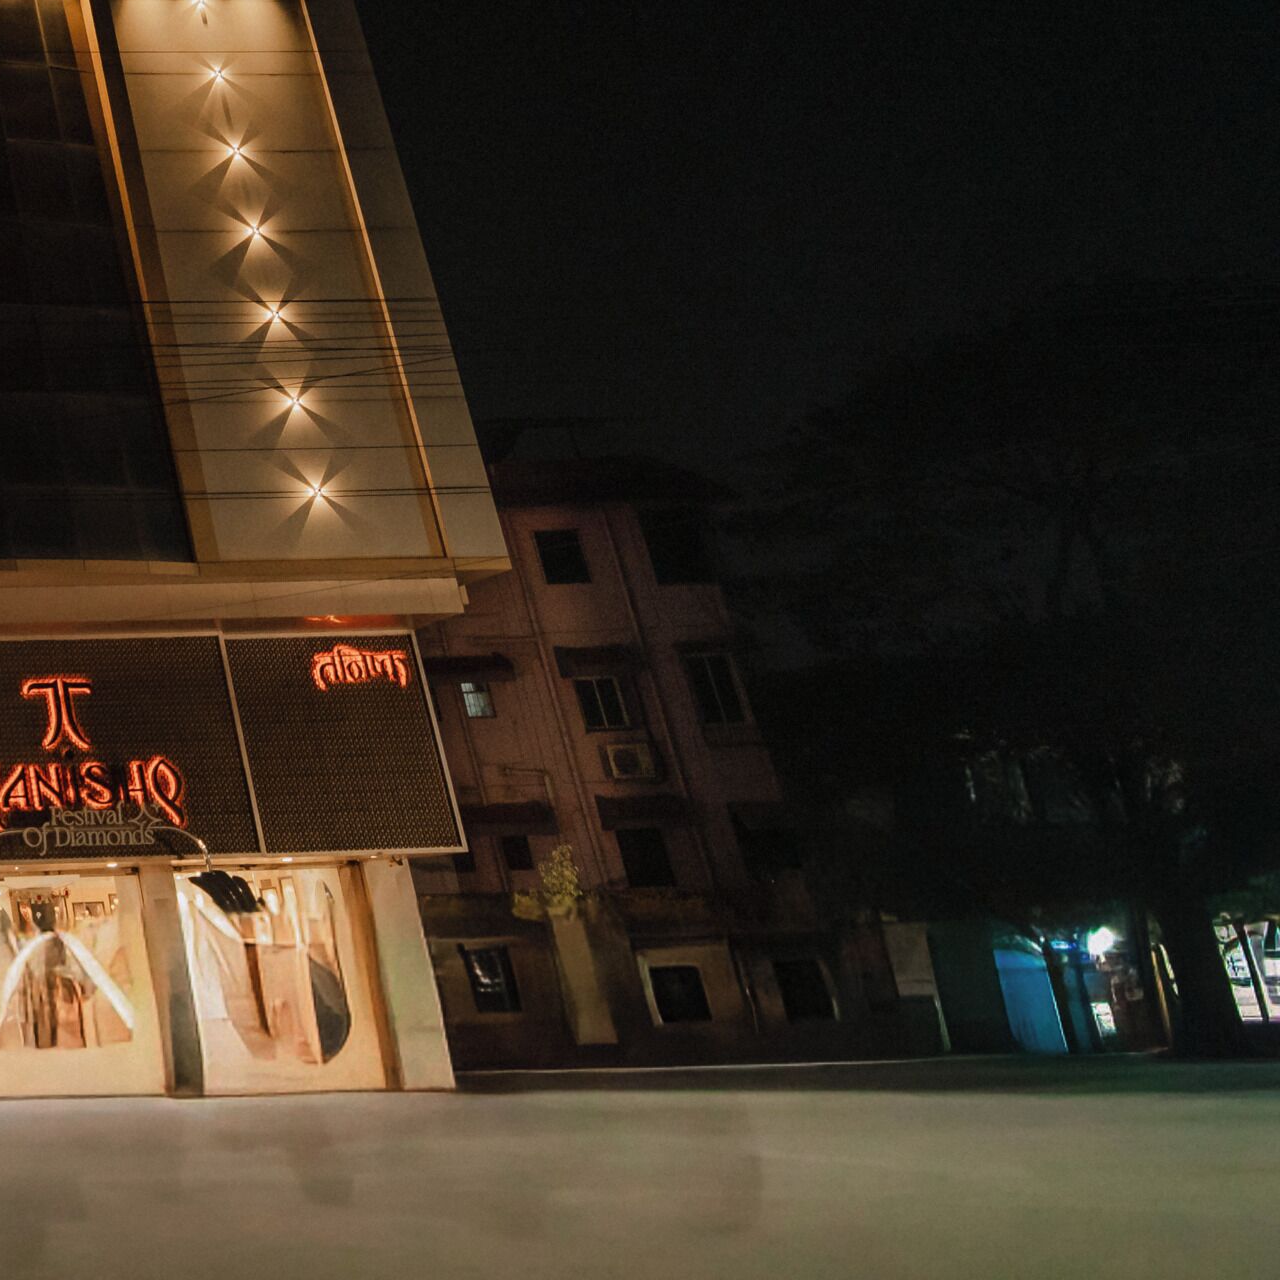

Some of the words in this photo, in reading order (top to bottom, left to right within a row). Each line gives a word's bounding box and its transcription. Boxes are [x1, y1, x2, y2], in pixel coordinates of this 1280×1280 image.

[50, 802, 124, 826] Festival
[22, 822, 50, 856] Of
[55, 826, 156, 848] Diamonds
